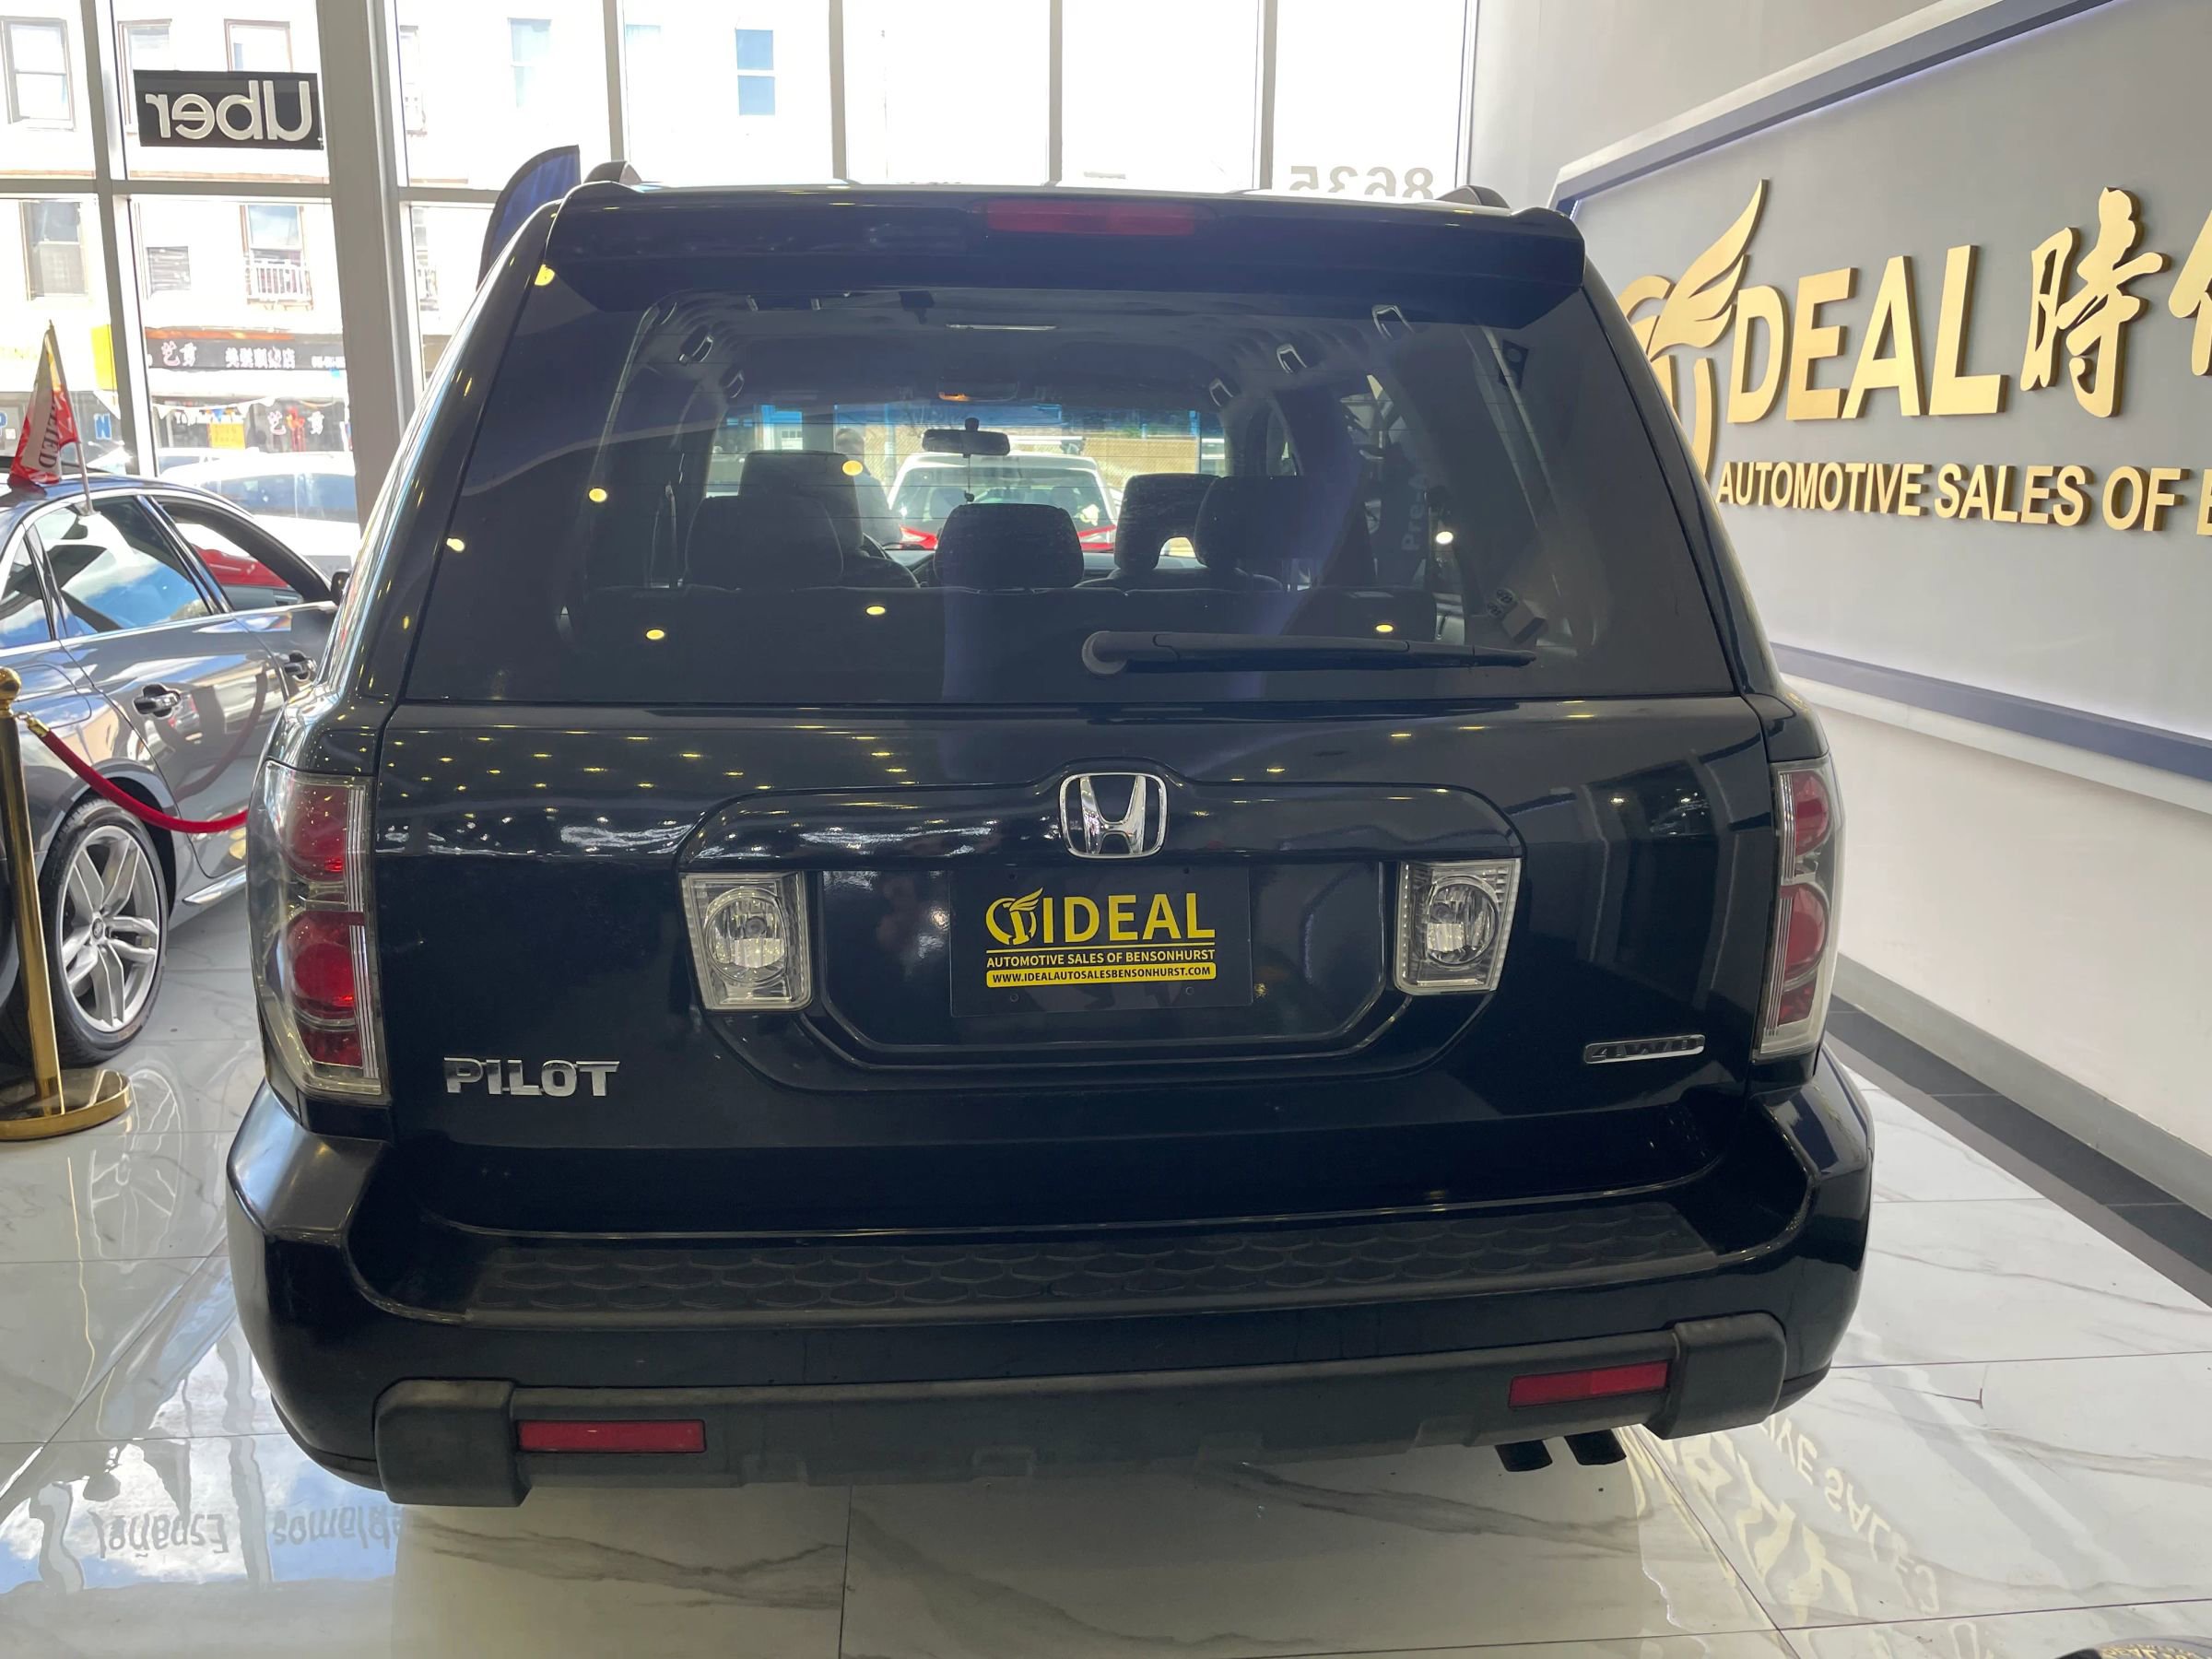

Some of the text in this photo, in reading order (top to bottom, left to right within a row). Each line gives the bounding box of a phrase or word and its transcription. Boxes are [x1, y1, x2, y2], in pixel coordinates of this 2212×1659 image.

[1716, 461, 1929, 516] AUTOMOTIVE
[1934, 463, 2090, 527] SALES
[2101, 465, 2188, 532] OF
[1042, 892, 1216, 944] IDEAL
[986, 949, 1216, 968] AUTOMOTIVE SALES OF BENSONHURST
[992, 966, 1211, 983] WWW.IDEALAUTOSALESBENSONHURST.COM
[443, 1057, 620, 1097] PILOT
